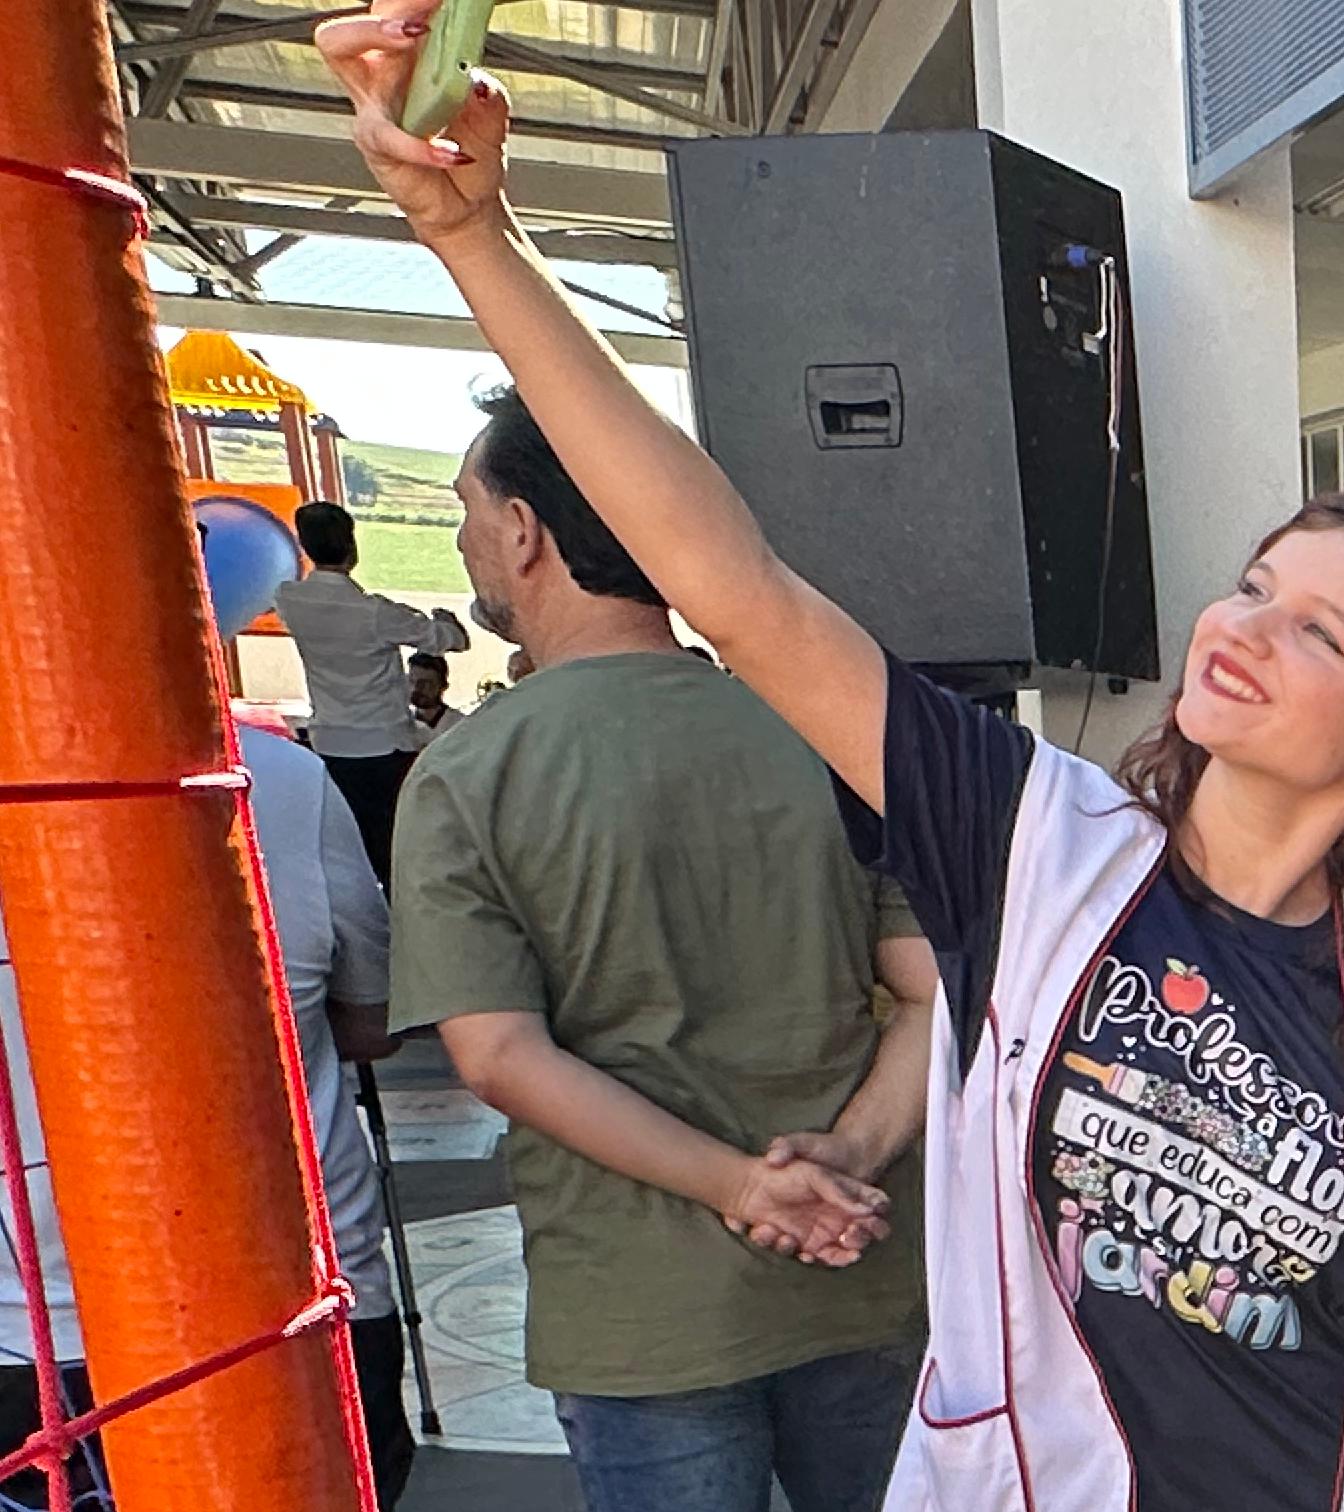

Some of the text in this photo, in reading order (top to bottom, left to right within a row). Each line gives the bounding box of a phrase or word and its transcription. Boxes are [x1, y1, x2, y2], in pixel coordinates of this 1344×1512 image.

[1080, 1112, 1332, 1255] que educa com
[1256, 1112, 1278, 1138] a
[1056, 1197, 1302, 1351] jardim
[1110, 1169, 1293, 1287] amor
